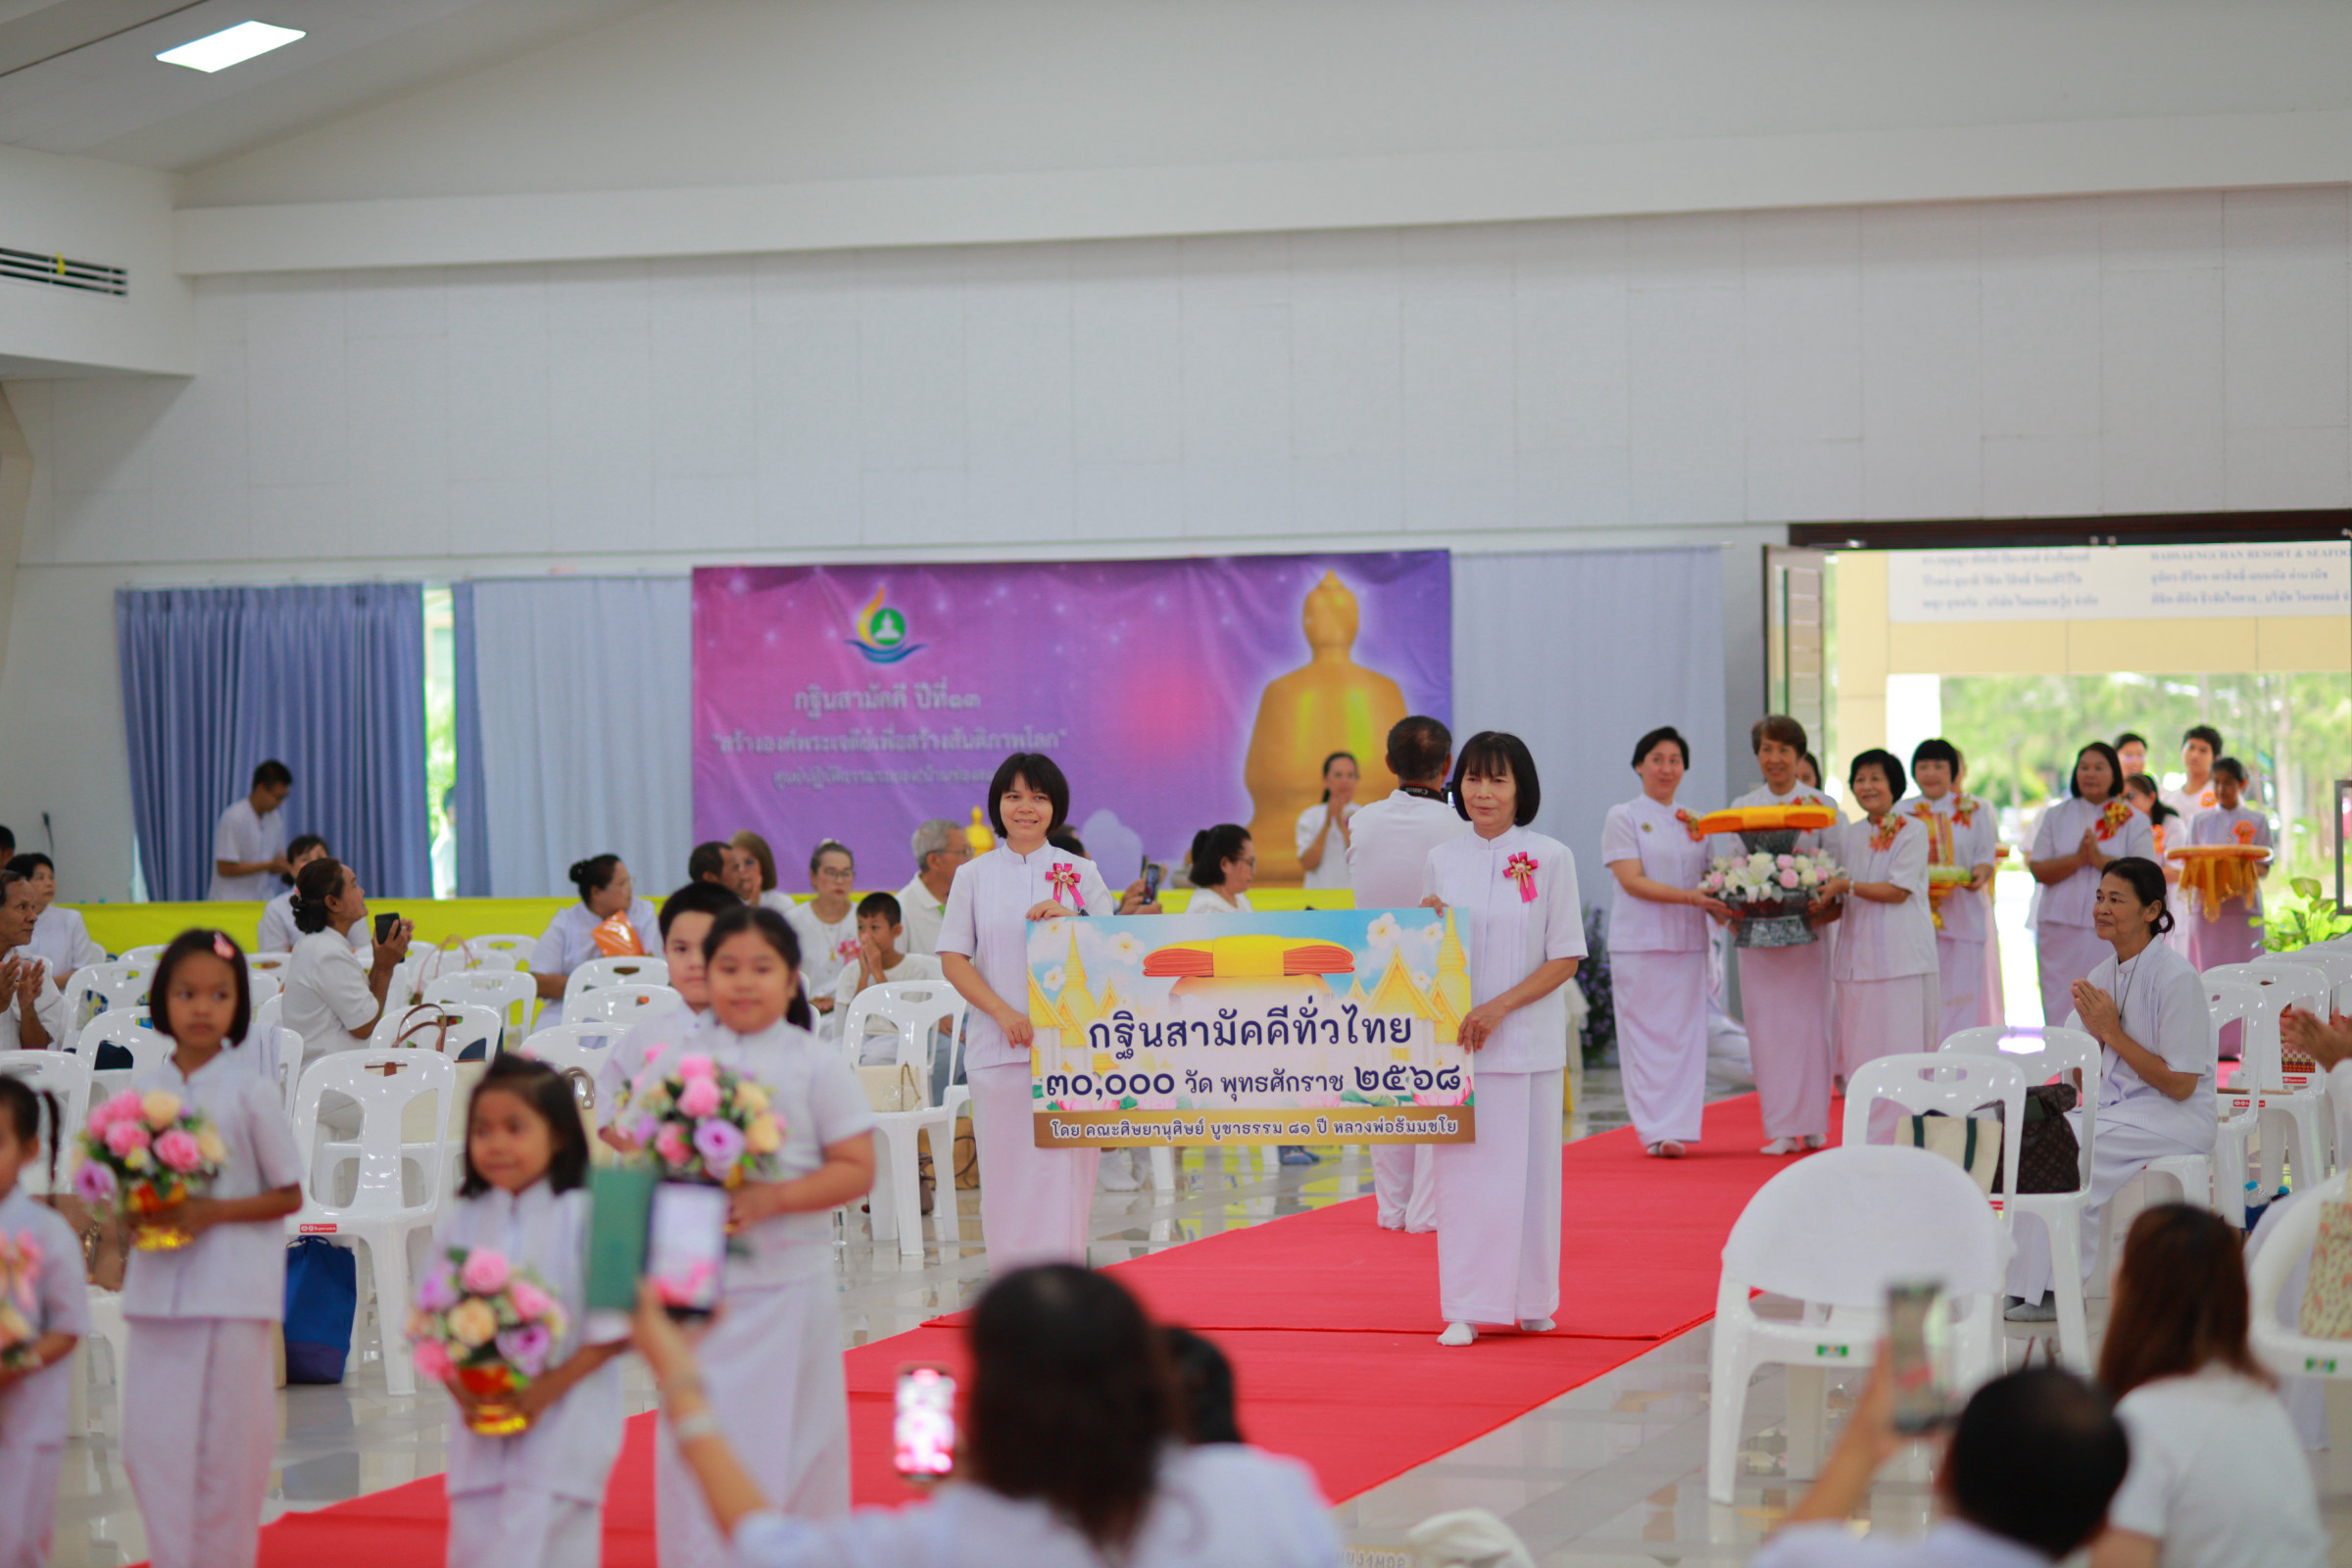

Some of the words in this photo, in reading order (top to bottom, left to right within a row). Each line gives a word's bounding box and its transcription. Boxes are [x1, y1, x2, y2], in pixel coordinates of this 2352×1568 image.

[794, 684, 907, 720] กฐินสามัคคี
[1089, 996, 1412, 1059] กฐินสามัคคีทั่วไทย
[1047, 1071, 1175, 1100] ๓๐,๐๐๐
[1186, 1069, 1213, 1095] วัด
[1221, 1068, 1344, 1102] พุทธศักราช
[1354, 1064, 1461, 1091] ๒๕๖๘
[1052, 1121, 1080, 1138] โดย
[1086, 1118, 1204, 1141] คณะศิษยานุศิษย์
[1210, 1121, 1282, 1140] บูชาธรรม
[1317, 1118, 1327, 1135] ปี
[1334, 1118, 1457, 1135] หลวงพ่อธัมมชโย
